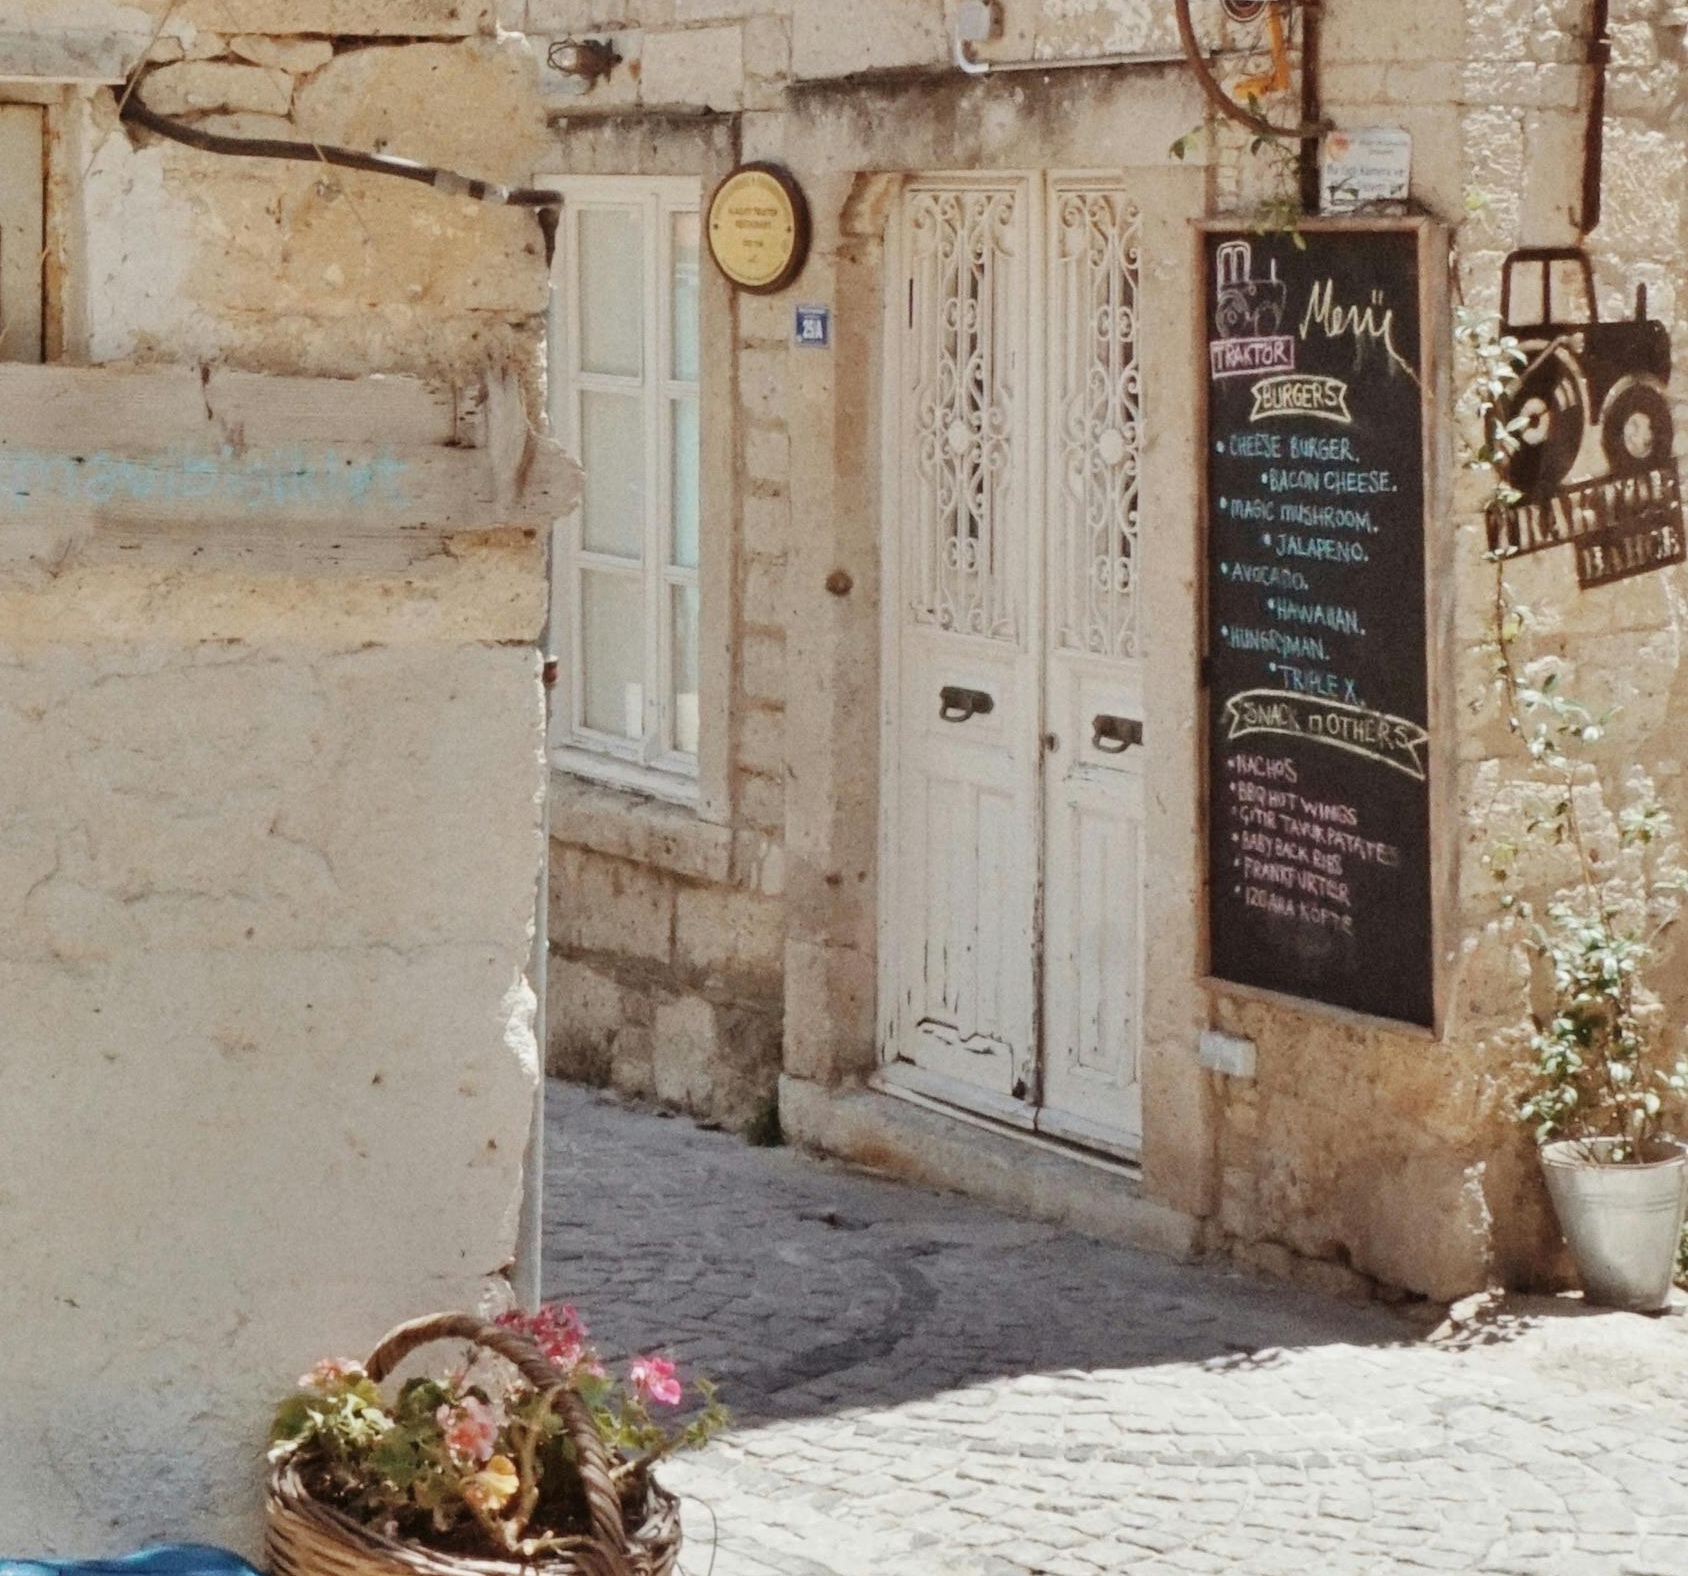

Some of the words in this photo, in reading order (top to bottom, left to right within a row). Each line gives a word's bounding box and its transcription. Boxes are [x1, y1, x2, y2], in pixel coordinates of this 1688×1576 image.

[1263, 383, 1338, 409] BURGERS
[1229, 434, 1282, 458] CHEESE
[1270, 468, 1320, 492] BACON
[1244, 702, 1301, 730] SNACK
[1327, 713, 1409, 750] OTHERS
[1237, 754, 1298, 783] NACHOS
